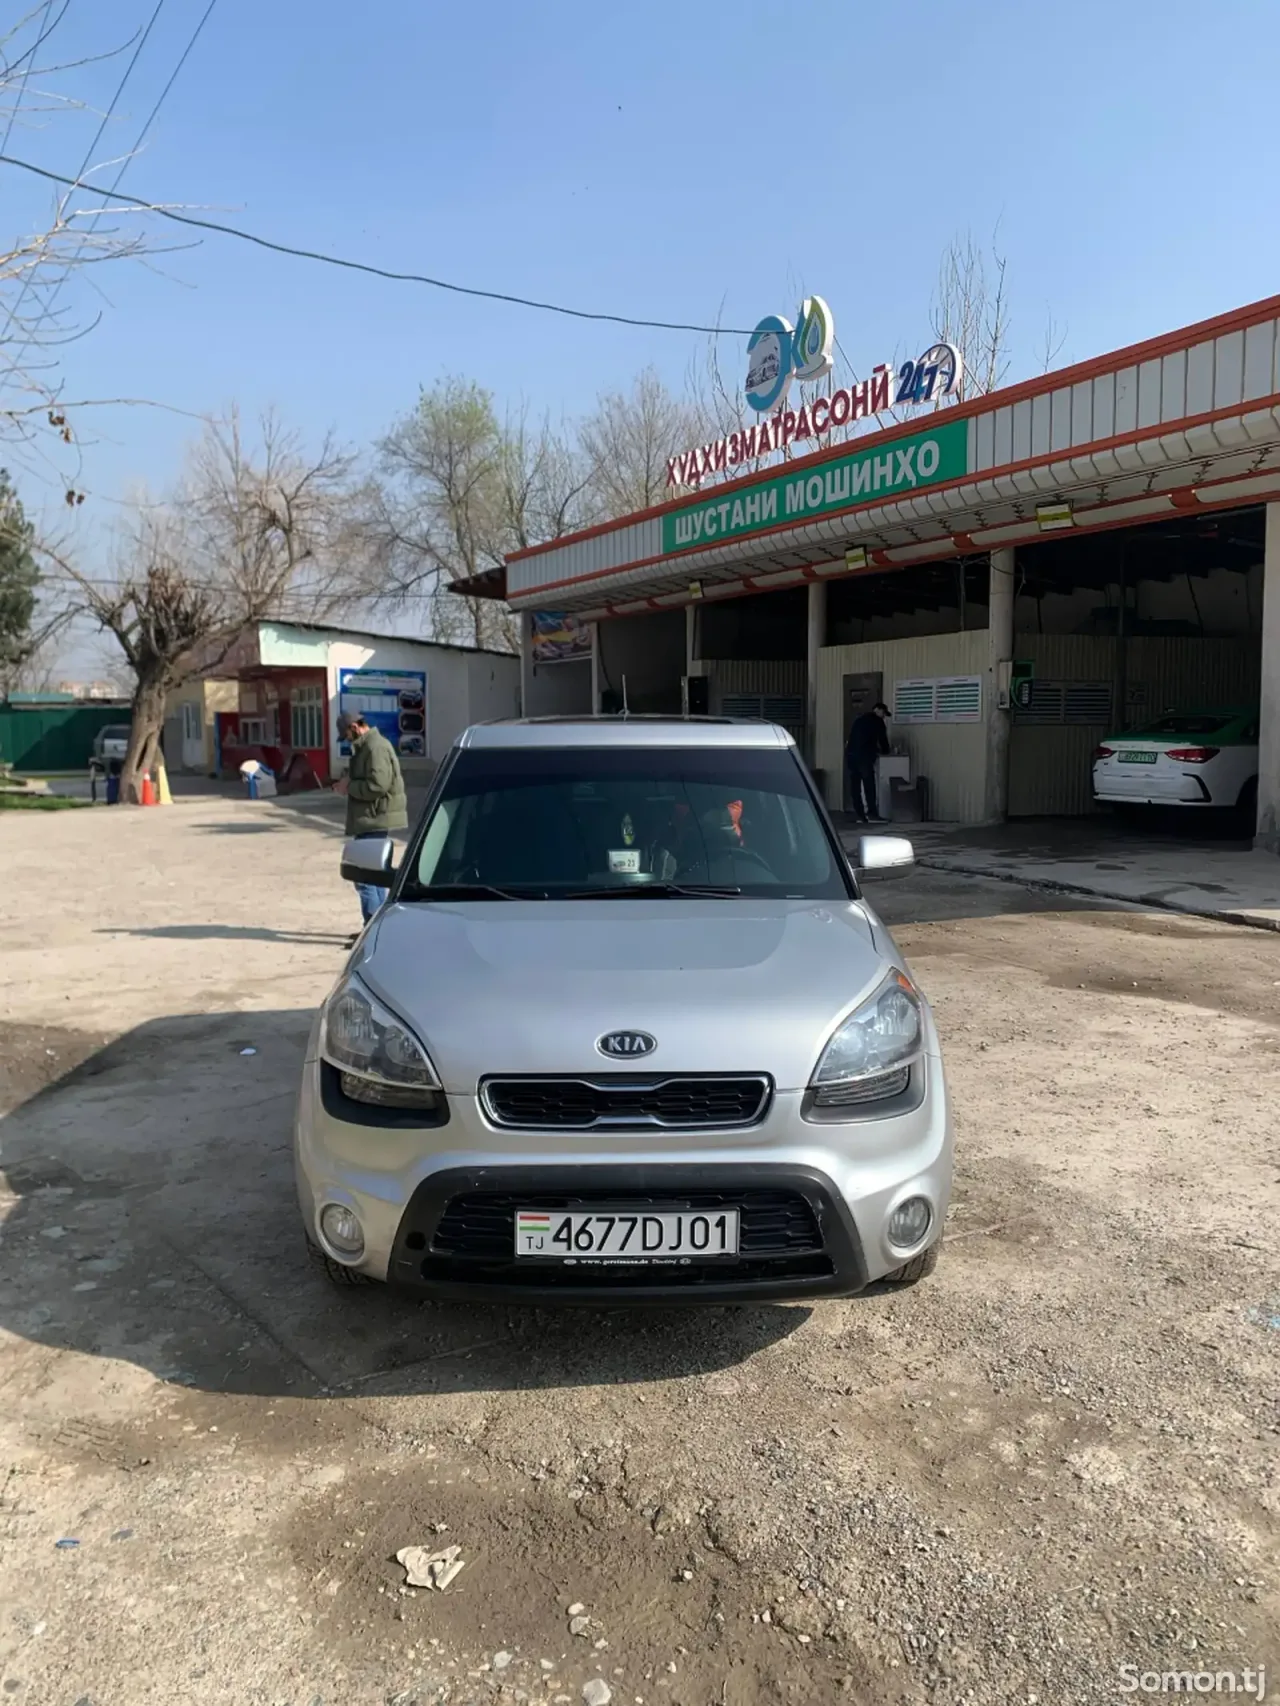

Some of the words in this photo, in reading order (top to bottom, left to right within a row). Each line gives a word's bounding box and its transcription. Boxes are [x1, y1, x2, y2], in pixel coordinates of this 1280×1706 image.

[675, 487, 777, 545] ШУСТАНИ
[785, 440, 940, 514] МОШИНҲО
[607, 1036, 646, 1051] KIA
[526, 1236, 544, 1250] TJ
[552, 1215, 727, 1251] 4677DJ01
